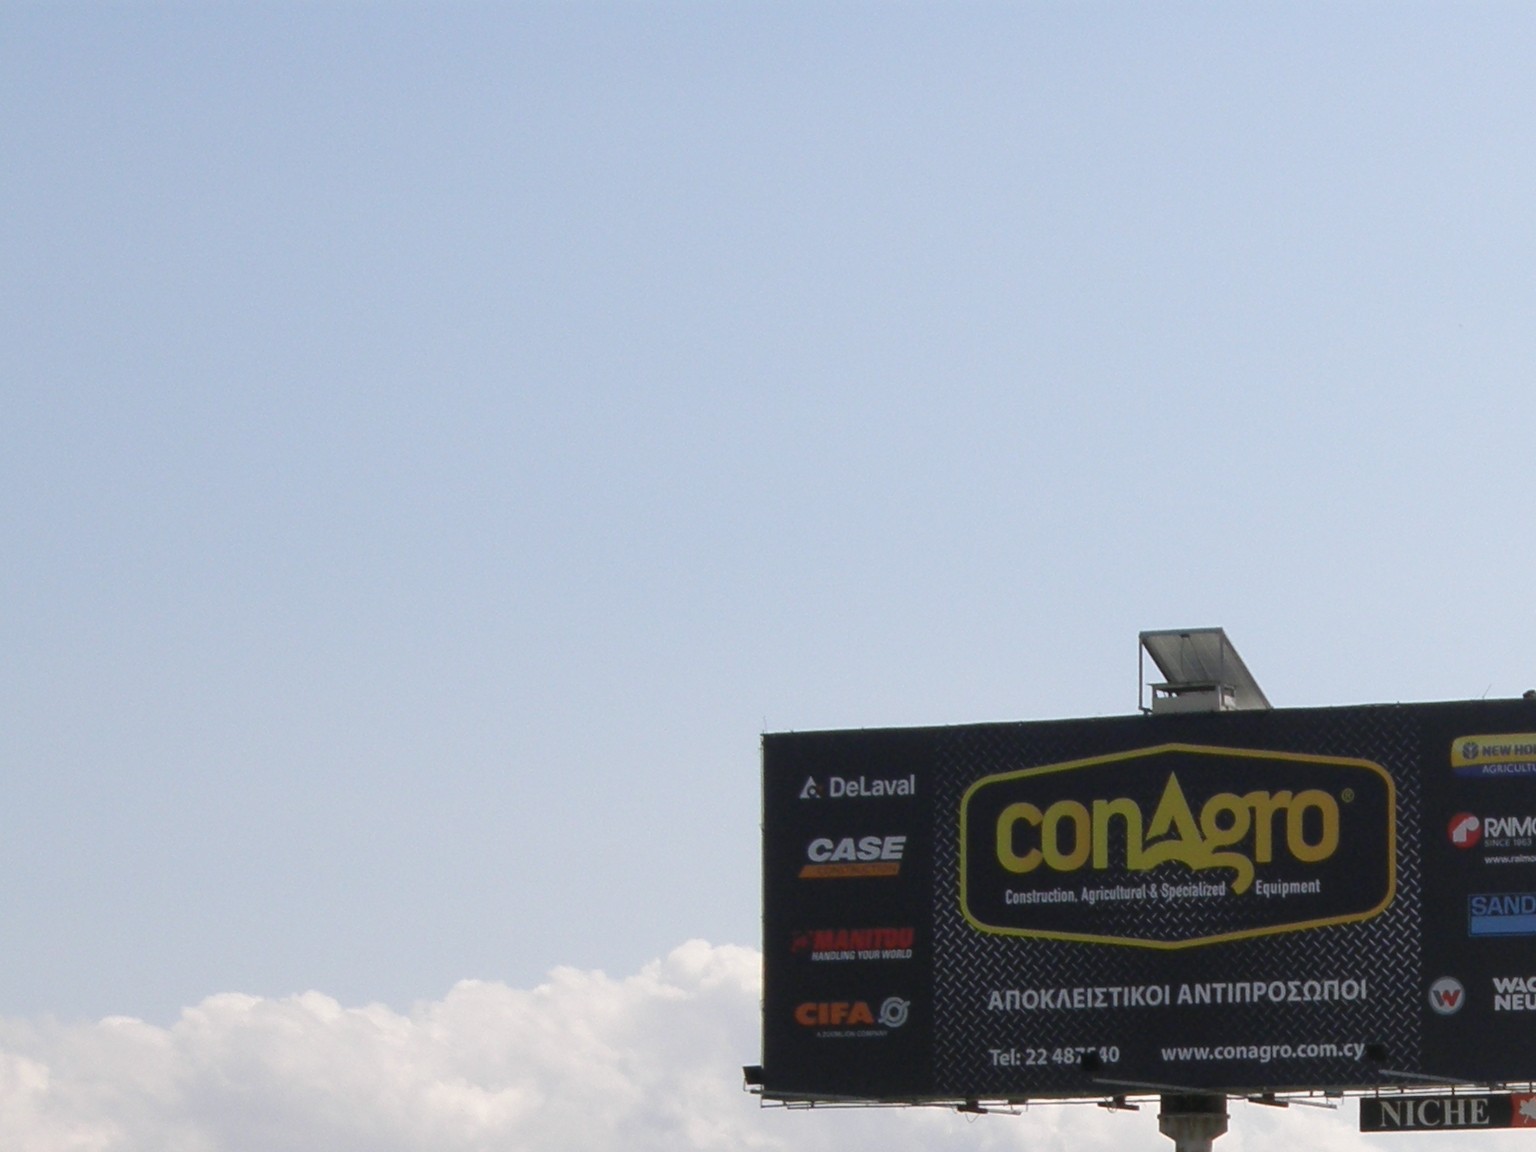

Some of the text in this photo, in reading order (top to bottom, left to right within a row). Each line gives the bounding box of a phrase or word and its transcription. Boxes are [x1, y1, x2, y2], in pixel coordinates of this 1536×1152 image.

[1482, 745, 1511, 757] NEW
[829, 774, 916, 797] DeLaval
[808, 836, 907, 862] CASE
[1484, 839, 1510, 848] SINCE
[1081, 884, 1147, 905] Agricultural
[1150, 883, 1158, 898] &
[1161, 881, 1226, 901] Specialized
[1255, 879, 1321, 896] Equipment
[812, 927, 916, 950] MANITOU
[811, 949, 913, 961] HANDLING YOUR WORLD
[987, 979, 1368, 1010] ΑΠΟΚΛΕΙΣΤΙΚΟΙ ΑΝΤΙΠΡΟΣΩΠΟΙ
[794, 1001, 875, 1026] CIFA
[989, 1049, 1021, 1066] Tel:
[1026, 1049, 1047, 1065] 22
[1161, 1043, 1366, 1063] www.conagro.com.cy
[1380, 1098, 1490, 1127] NICHE
